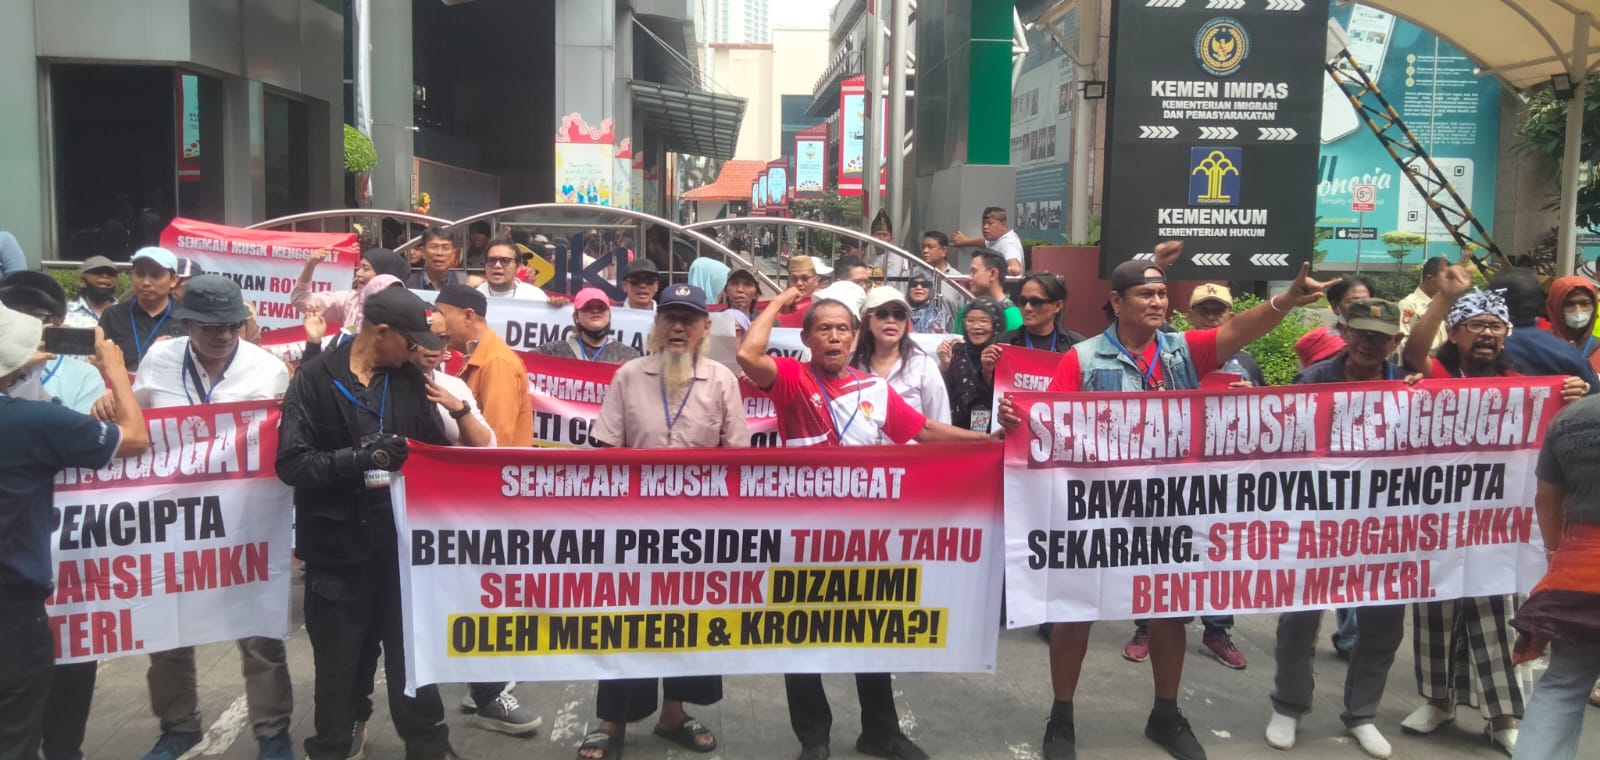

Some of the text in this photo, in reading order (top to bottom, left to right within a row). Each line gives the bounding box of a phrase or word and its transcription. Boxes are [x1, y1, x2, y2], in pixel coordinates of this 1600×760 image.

[1151, 80, 1289, 99] KEMEN IMIPAS
[1162, 100, 1278, 111] KEMENTERIAN IMIGRASI
[1163, 110, 1275, 120] DAN PEMASYARAKATAN
[1158, 208, 1268, 225] KEMENKUM
[1159, 227, 1265, 237] KEMENTERIAN HUKUM
[177, 235, 339, 264] SENIMAN MUSIK MENGGAT
[1029, 398, 1191, 463] SENIMAN
[1204, 393, 1318, 456] MUSIK
[1330, 386, 1550, 451] MENGGUGAT
[501, 464, 906, 499] SENIMAN MUSIK MENGGUGAT
[1067, 463, 1506, 521] BAYARKAN ROYALTI PENCIPTA
[411, 527, 983, 566] BENARKAH PRESIDEN TIDAK TAHU
[1027, 506, 1534, 570] SEKARANG. STOP AROGANSI LMKN
[45, 541, 269, 606] ANSI LMKN
[480, 568, 918, 609] SENIMAN MUSIK DIZALIMI
[1132, 559, 1437, 615] BENTUKAN MENTERI.
[452, 608, 941, 653] OLEH MENTERI & KRONINYA?!
